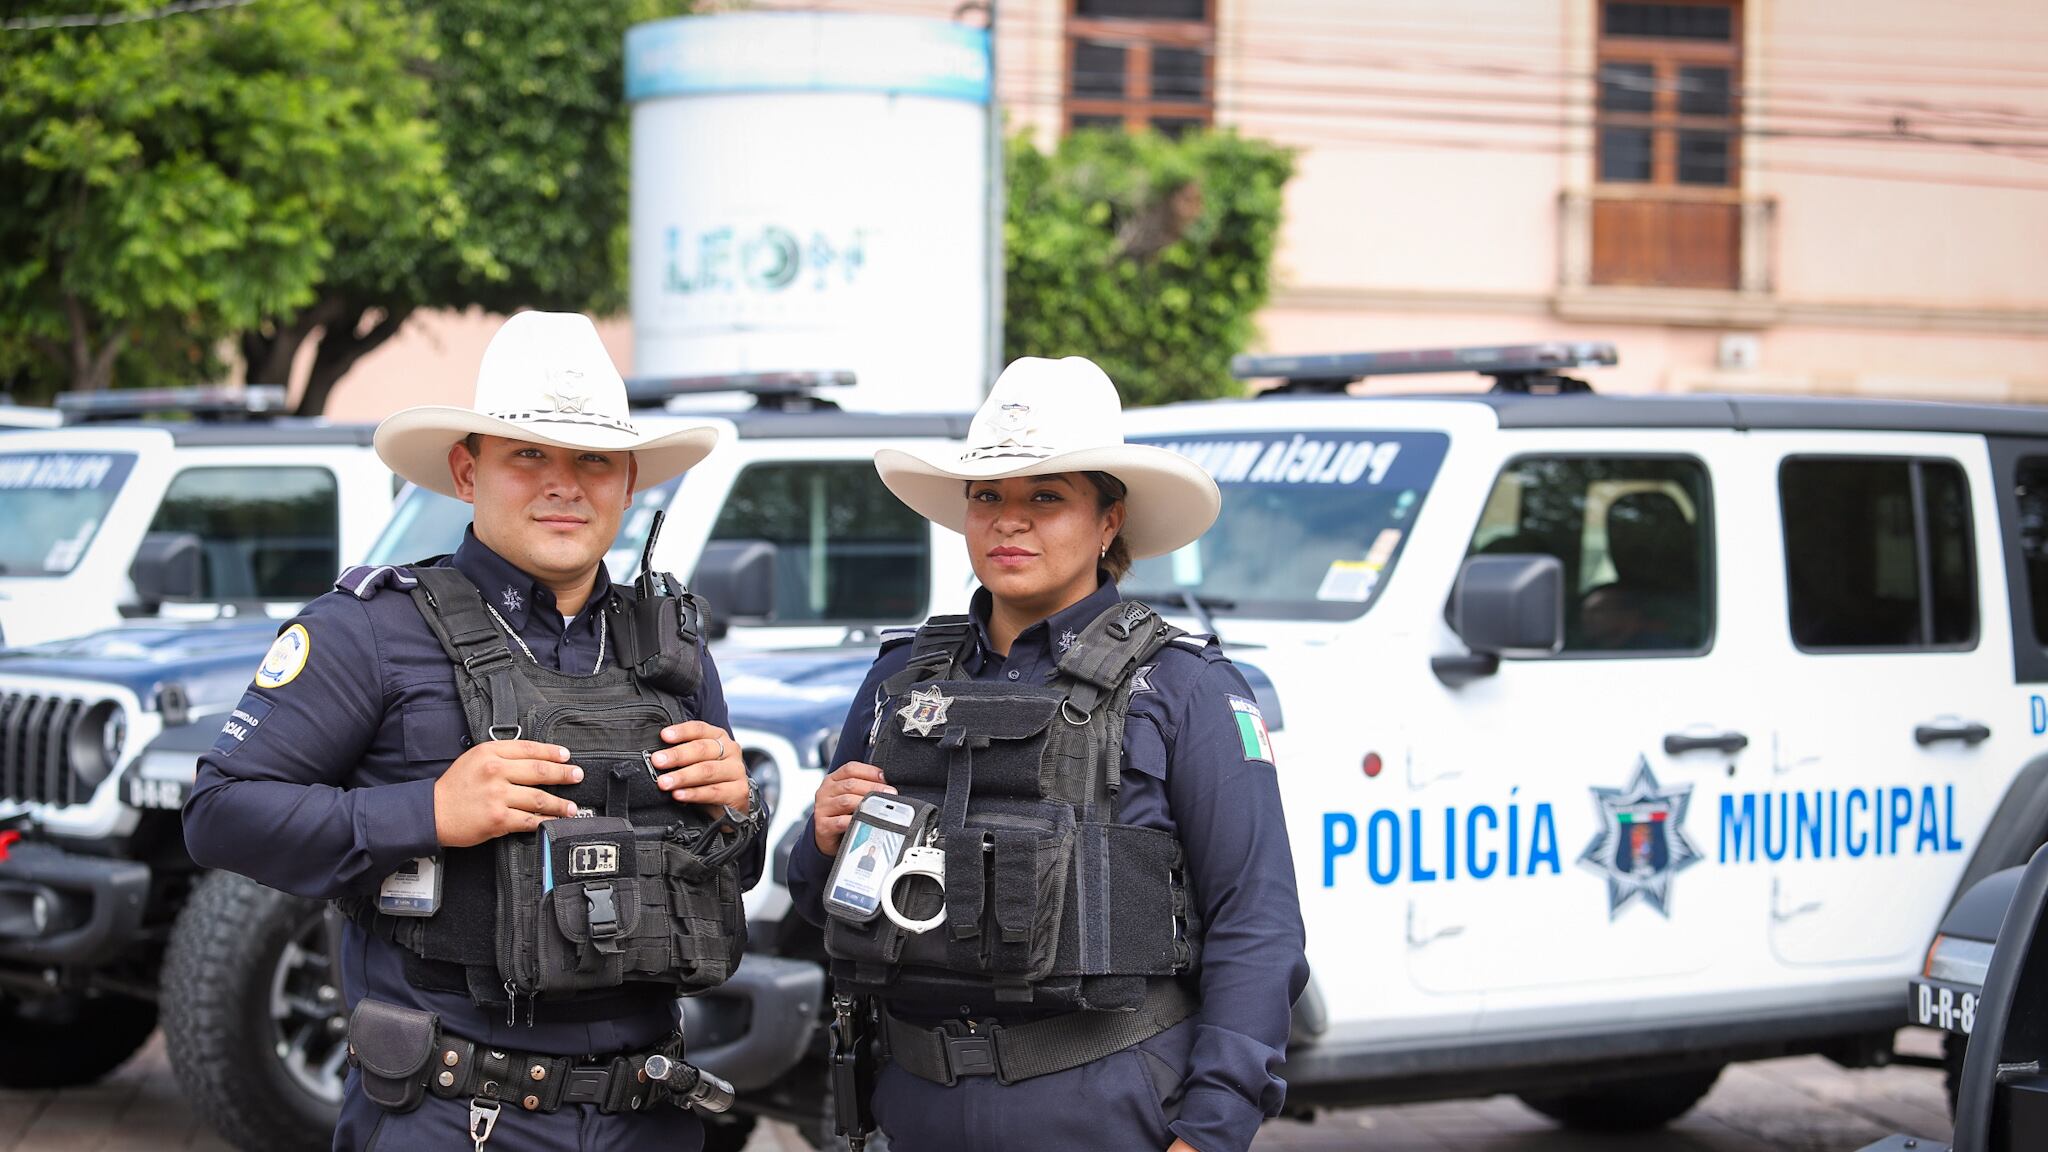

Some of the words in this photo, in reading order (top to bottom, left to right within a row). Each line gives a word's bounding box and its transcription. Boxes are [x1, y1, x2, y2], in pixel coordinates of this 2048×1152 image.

[222, 720, 248, 741] OCIAL
[1323, 786, 1561, 887] POLICÍA
[1719, 784, 1963, 864] MUNICIPAL
[1918, 983, 1980, 1034] D-R-8
